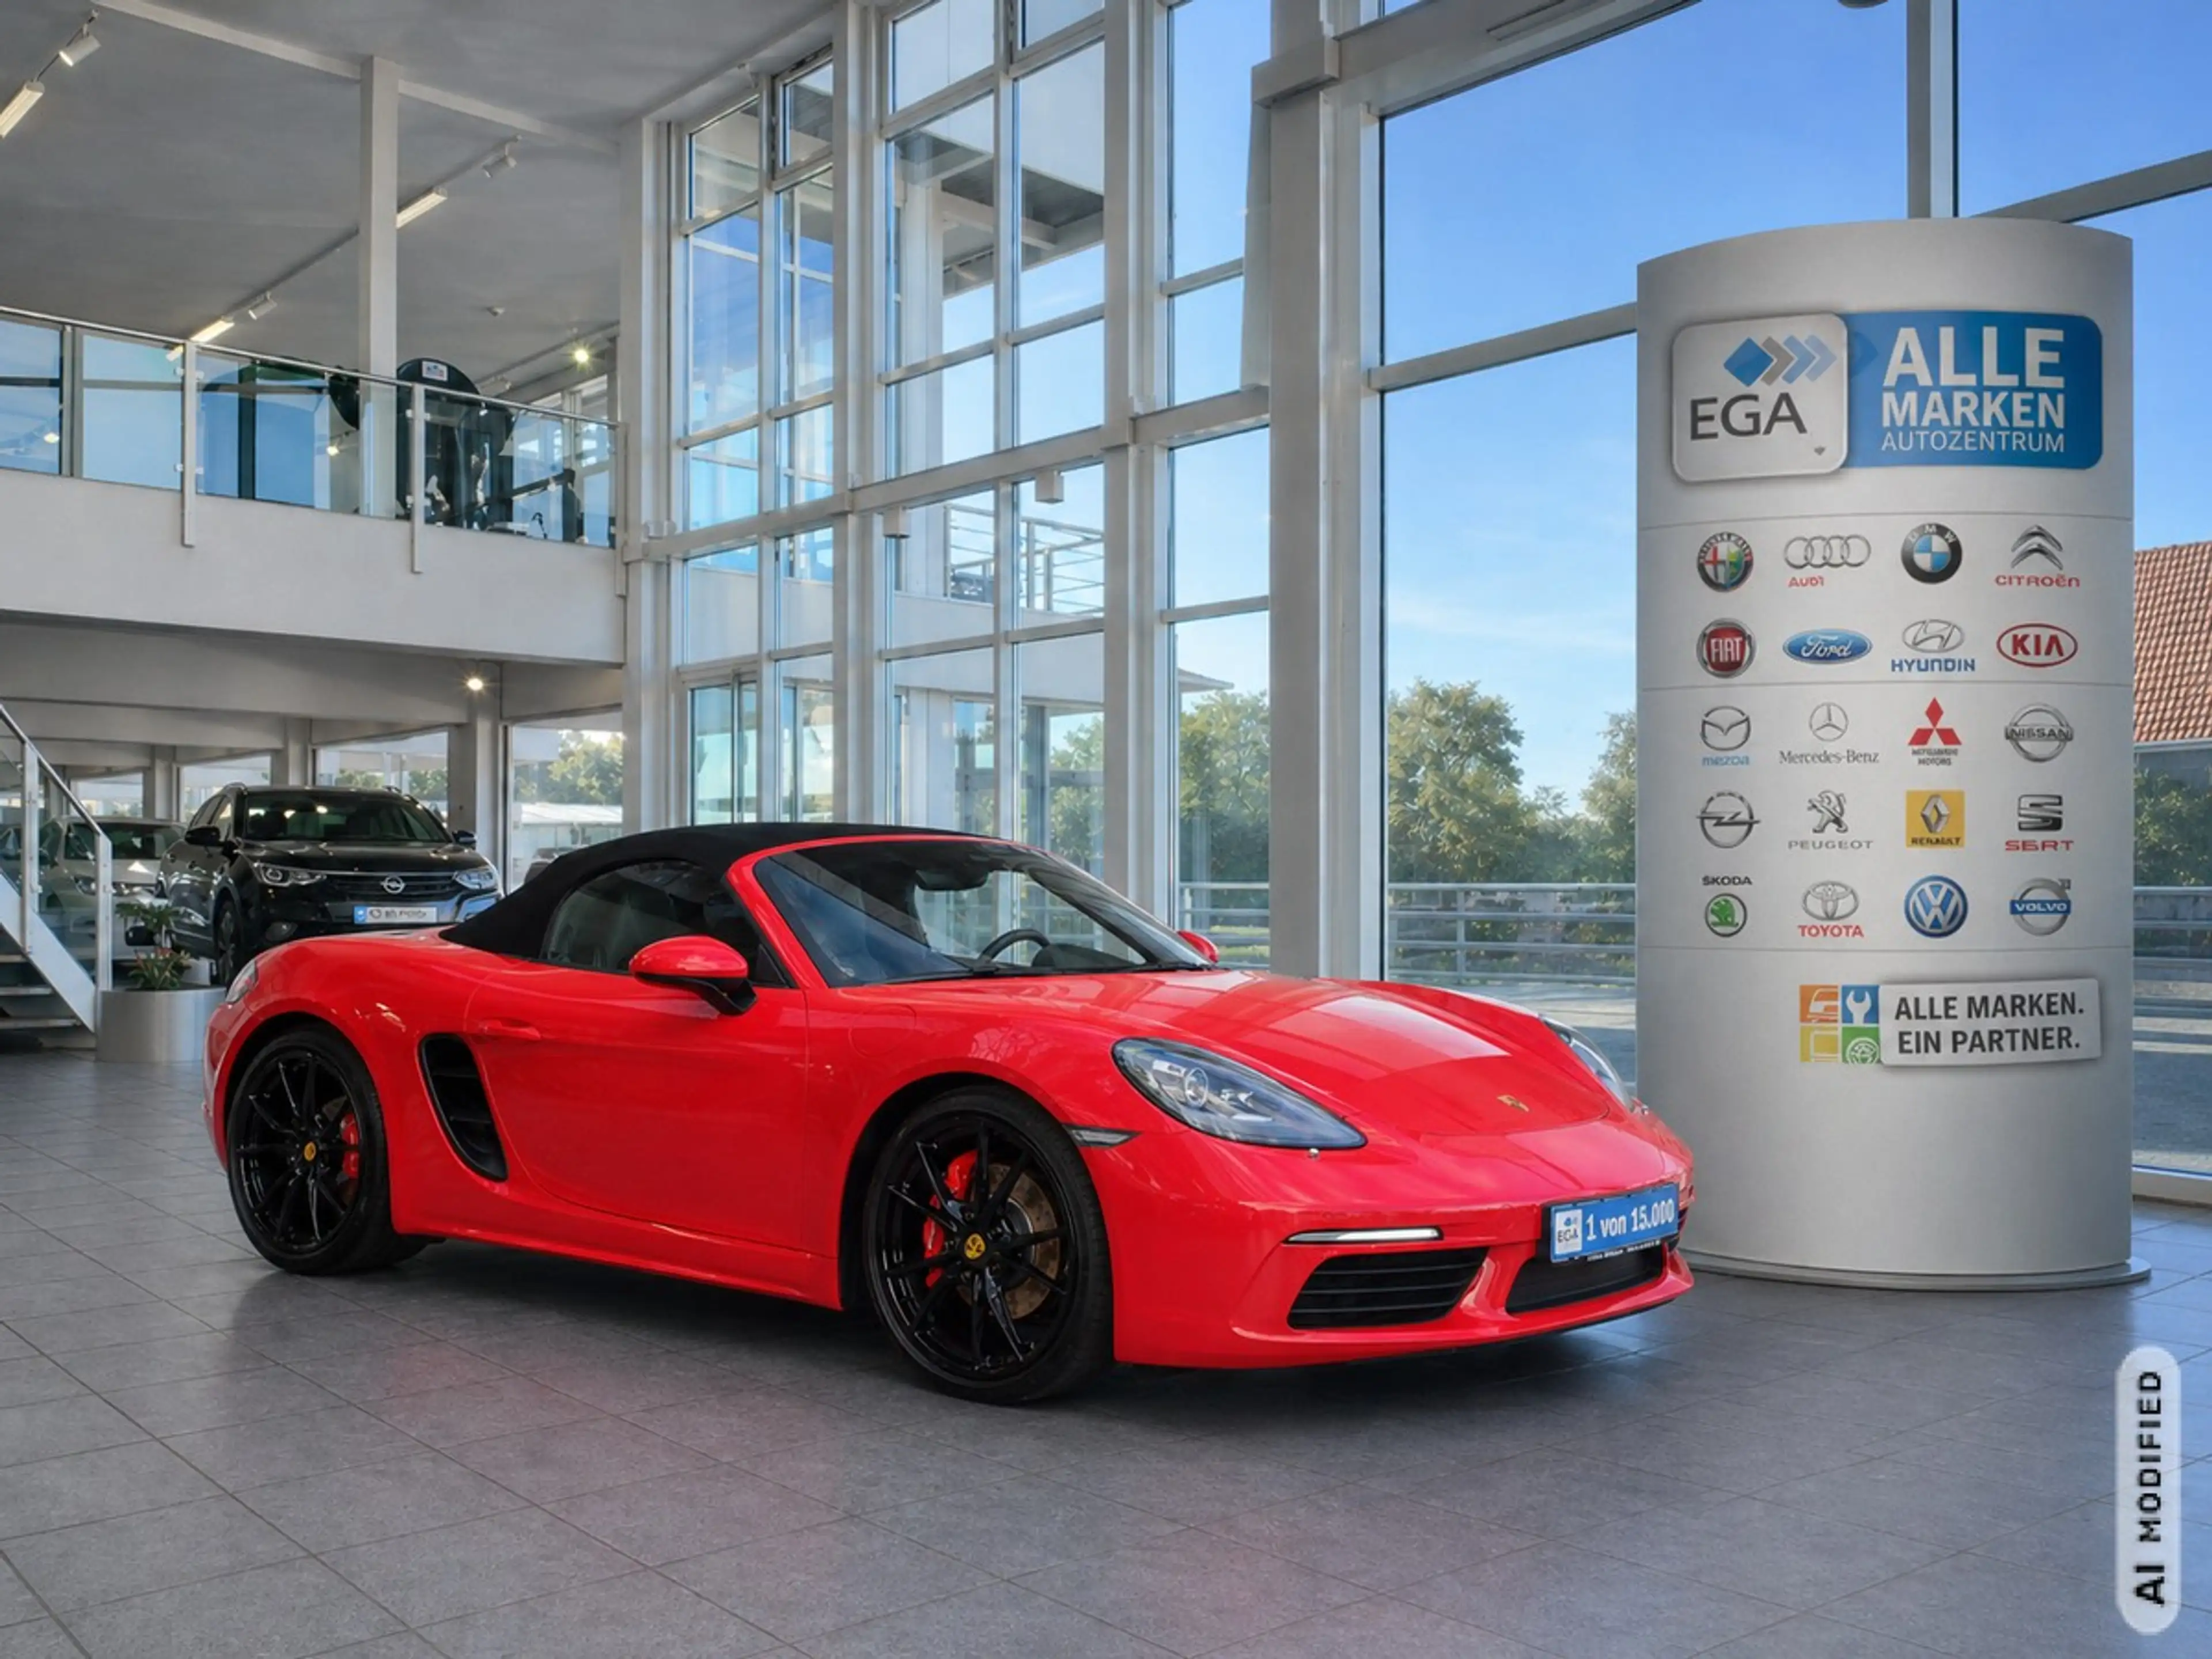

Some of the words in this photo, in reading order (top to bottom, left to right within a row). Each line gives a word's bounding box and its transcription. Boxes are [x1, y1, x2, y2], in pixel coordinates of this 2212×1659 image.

[1883, 326, 2065, 389] ALLE
[1690, 393, 1808, 441] EGA
[1882, 391, 2065, 429] MARKEN
[1881, 430, 2065, 453] AUTOZENTRUM
[1710, 637, 1743, 662] FIAT
[1801, 635, 1853, 658] Ford
[2011, 634, 2064, 657] KIA
[2008, 727, 2071, 740] NISSAN
[1779, 750, 1880, 765] Mercedes-Benz
[1787, 839, 1874, 850] PEUGEOT
[2014, 902, 2067, 912] VOLVO
[1798, 924, 1864, 938] TOYOTA
[1895, 996, 1958, 1020] ALLE
[1966, 992, 2085, 1018] MARKEN.
[1898, 1031, 1941, 1054] EIN
[1952, 1027, 2081, 1053] PARTNER.
[1586, 1213, 1597, 1241] 1
[1600, 1215, 1627, 1237] von
[1631, 1198, 1675, 1232] 15.000
